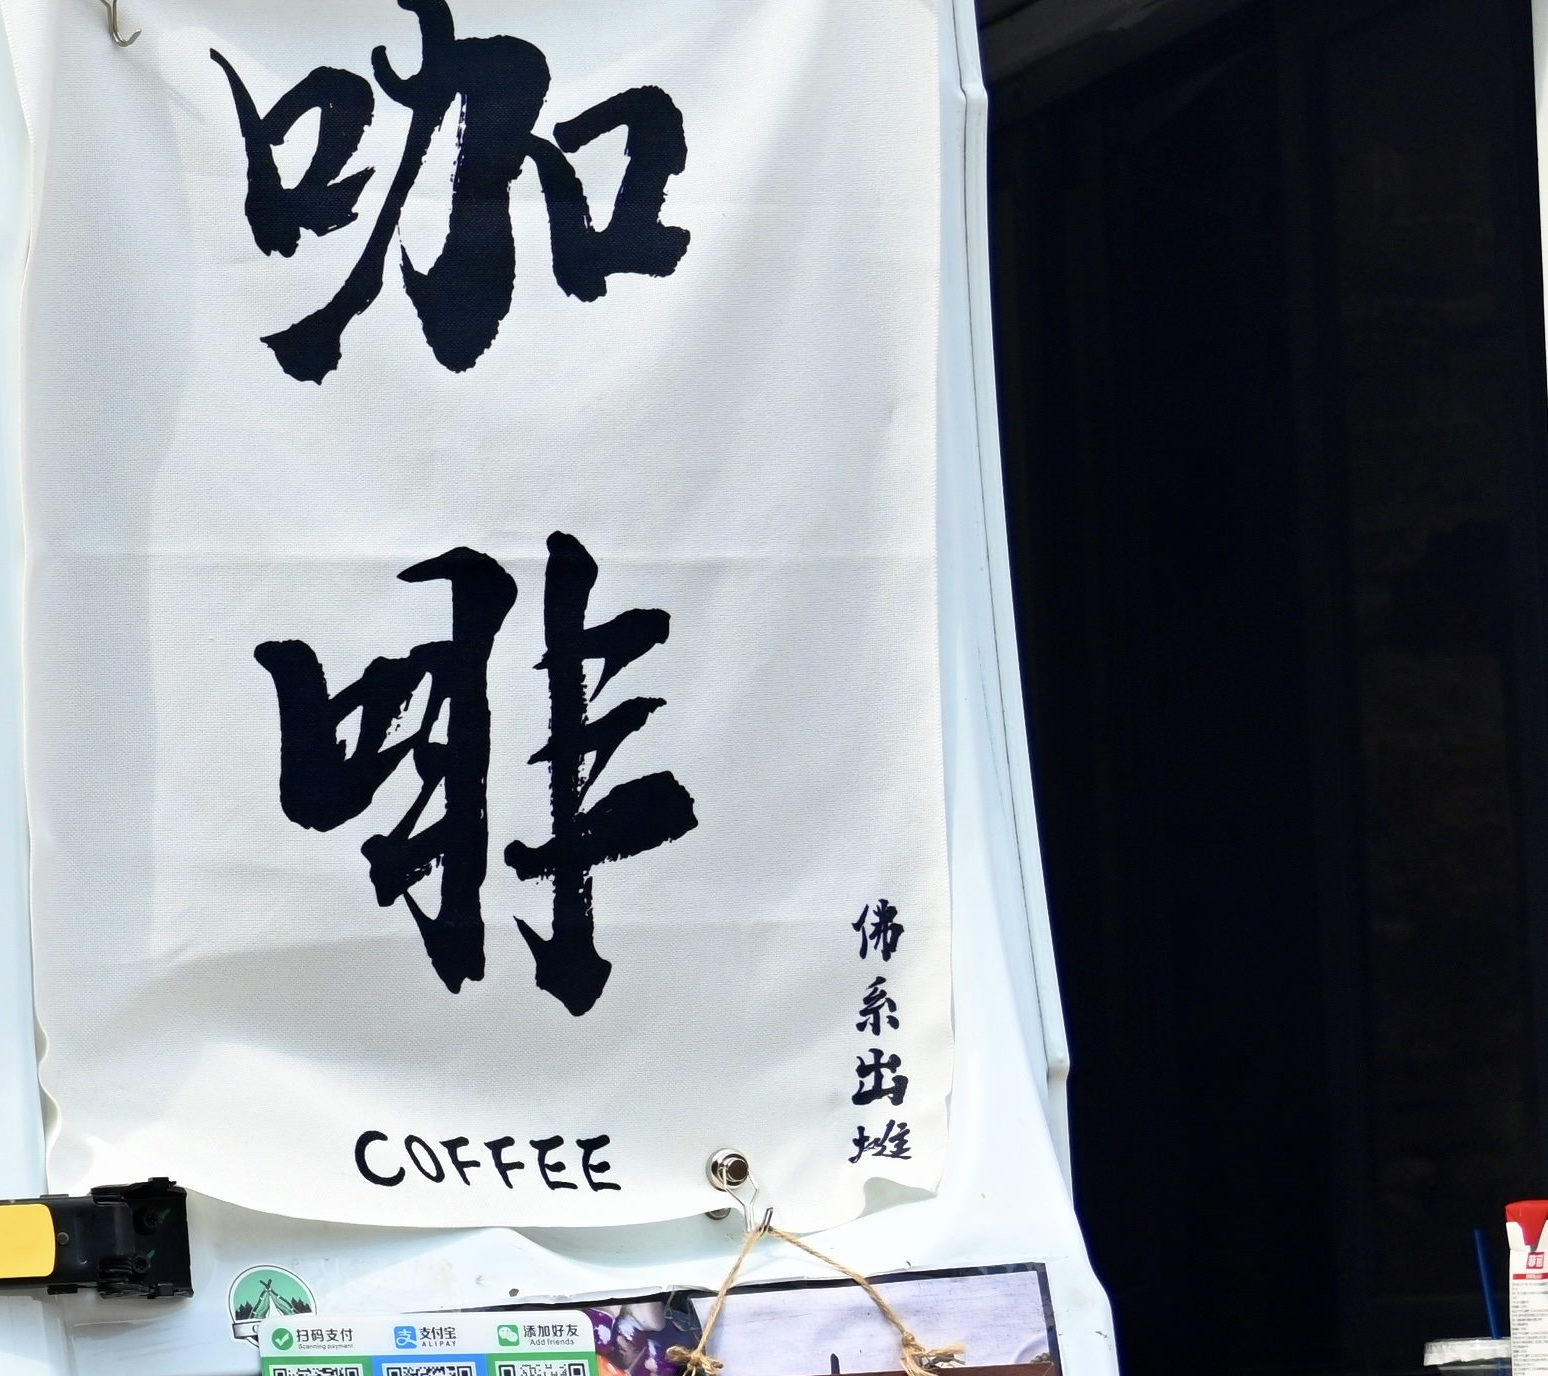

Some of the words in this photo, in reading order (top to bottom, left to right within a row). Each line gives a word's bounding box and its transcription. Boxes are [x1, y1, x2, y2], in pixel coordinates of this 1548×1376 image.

[356, 1130, 622, 1193] COFFEE
[295, 1329, 353, 1342] 扫码支付
[419, 1326, 457, 1340] 支付宝
[523, 1324, 579, 1338] 添加好友
[422, 1339, 457, 1347] ALIPAY
